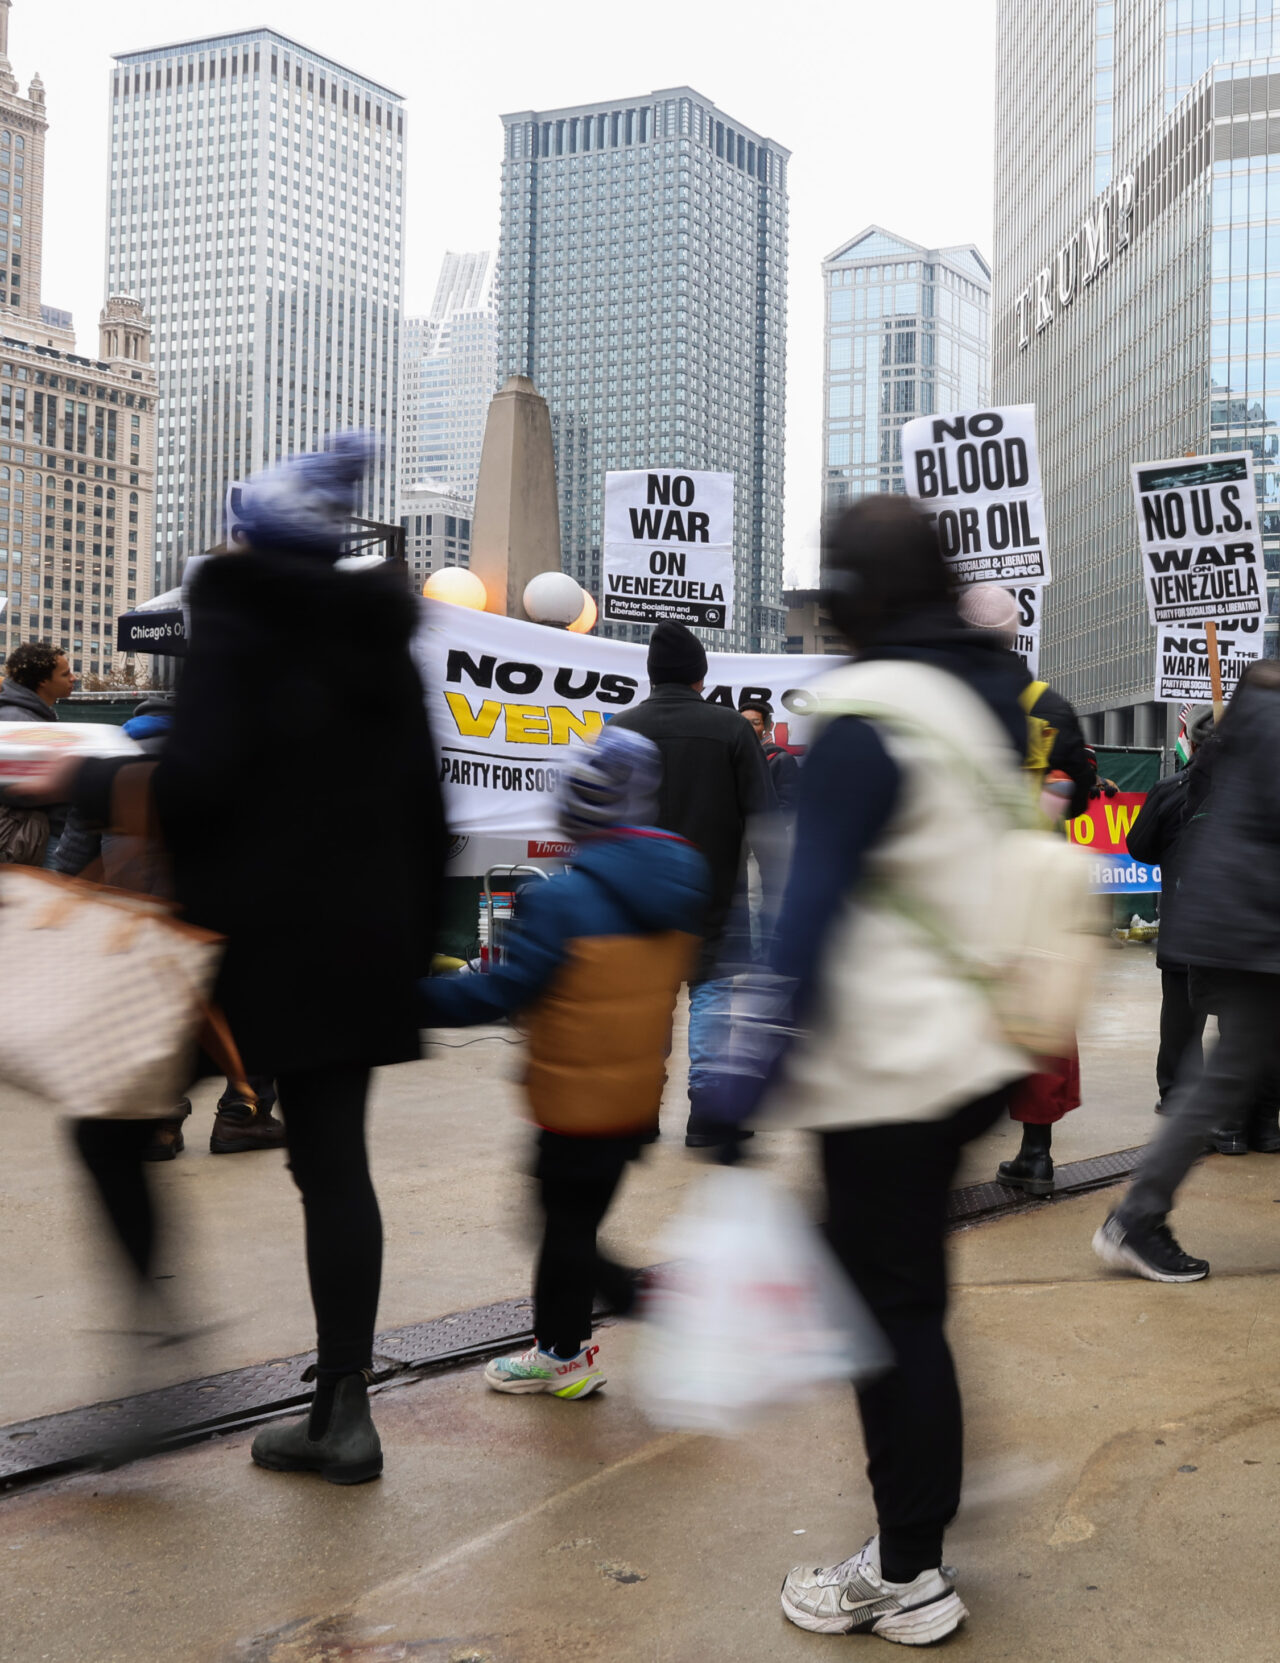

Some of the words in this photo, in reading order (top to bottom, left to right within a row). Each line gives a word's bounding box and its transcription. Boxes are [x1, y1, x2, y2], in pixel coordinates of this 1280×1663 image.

[1016, 174, 1134, 352] TRUMP
[933, 413, 1003, 443] NO
[915, 437, 1029, 499] BLOOD
[647, 473, 695, 507] NO
[1141, 492, 1187, 542] NO
[1190, 485, 1252, 536] U.S.
[629, 508, 710, 543] WAR
[986, 501, 1040, 551] OIL
[649, 550, 686, 577] ON
[959, 558, 992, 572] SOCIALISM
[992, 557, 1001, 568] &
[1001, 553, 1041, 566] LIBERATION
[1148, 542, 1257, 574] WAR
[958, 564, 1041, 582] WEB.ORG
[1192, 565, 1212, 574] ON
[608, 574, 724, 602] VENEZUELA
[1150, 567, 1259, 605] VENEZUELA
[610, 599, 629, 609] Party
[630, 601, 640, 609] for
[641, 602, 675, 612] Socialism
[676, 605, 690, 613] and
[610, 606, 645, 617] Liberation
[655, 611, 699, 622] PSLWeb.org
[1156, 609, 1174, 619] PARTY
[1174, 608, 1186, 618] FOR
[1185, 606, 1217, 617] SOCIALISM
[1217, 605, 1225, 613] &
[1225, 602, 1259, 613] LIBERATION
[130, 623, 172, 641] Chicago's
[1014, 634, 1034, 652] ITH
[1163, 637, 1235, 656] NOT
[1234, 651, 1258, 659] THE
[446, 649, 543, 695] NO
[554, 667, 639, 705] US
[1162, 655, 1195, 677] WAR
[1162, 679, 1179, 688] PARTY
[1180, 680, 1190, 689] FOR
[440, 757, 490, 788] PARTY
[492, 766, 522, 791] FOR
[535, 841, 579, 857] Throug
[1088, 862, 1148, 884] Hands
